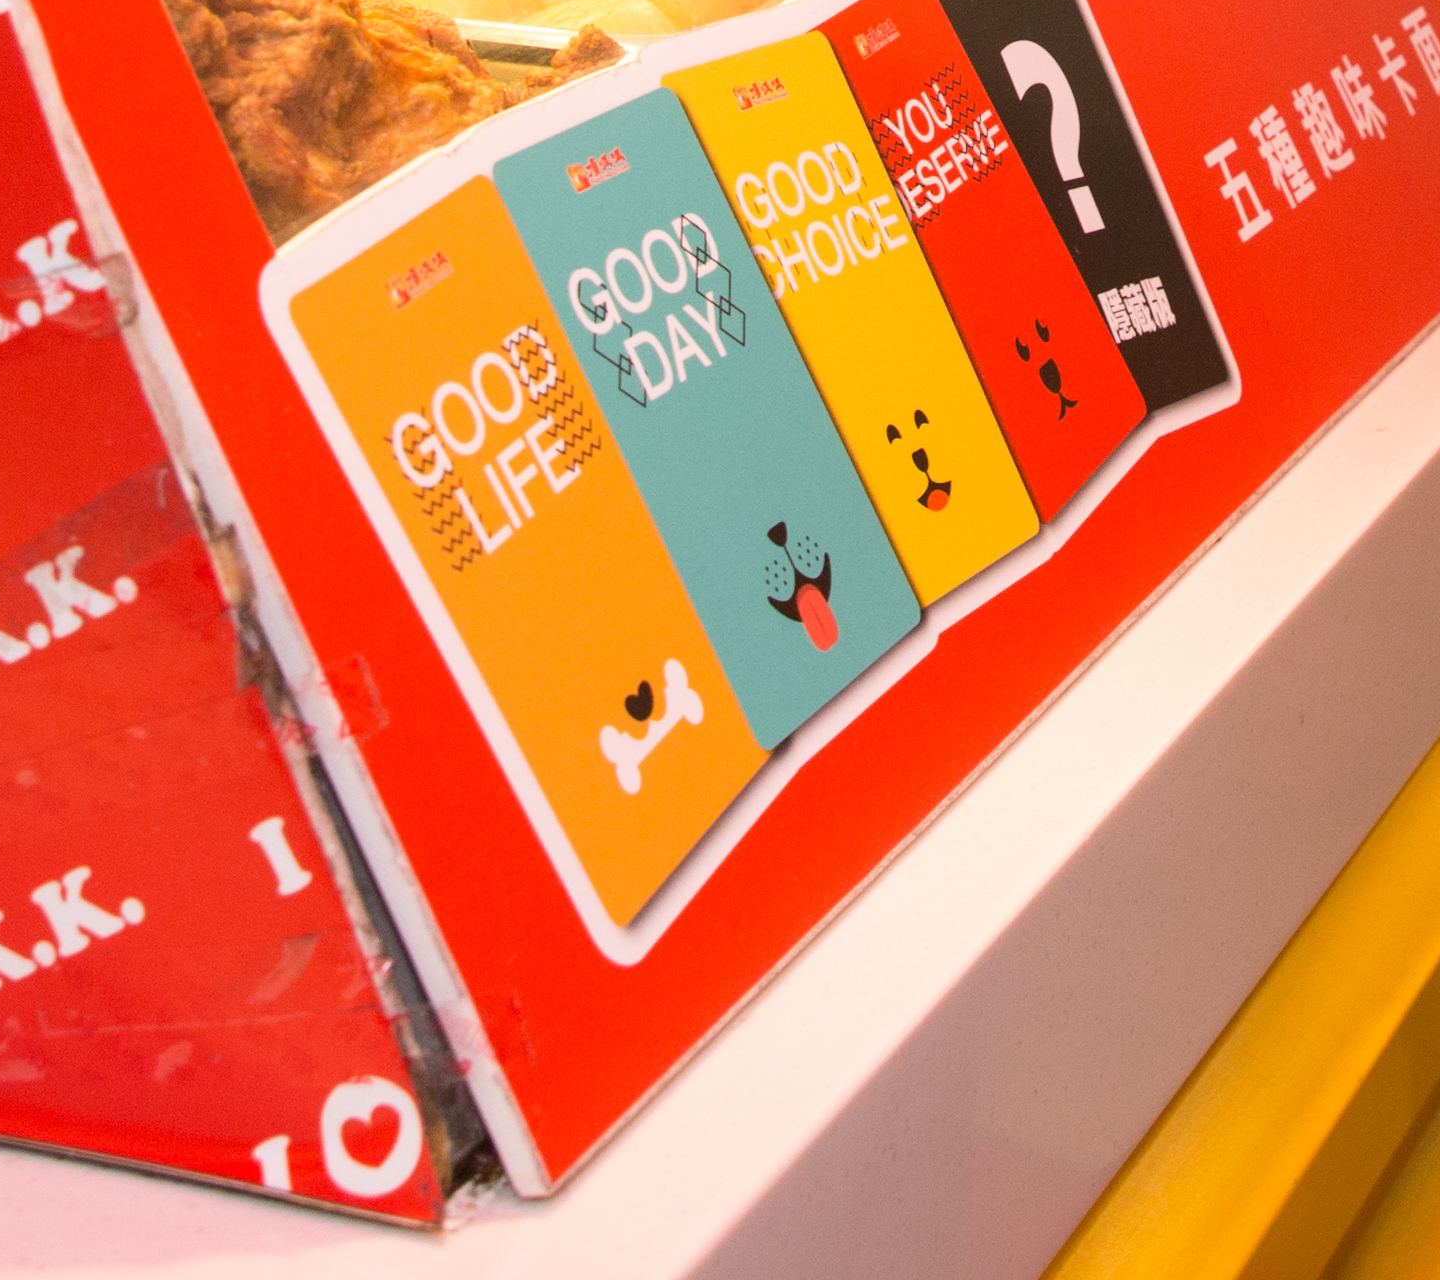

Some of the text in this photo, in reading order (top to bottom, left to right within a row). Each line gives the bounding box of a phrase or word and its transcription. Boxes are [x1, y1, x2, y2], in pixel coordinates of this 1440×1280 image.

[883, 83, 954, 156] YOU
[734, 140, 863, 230] GOOD
[567, 212, 721, 336] GOOD
[1097, 275, 1177, 345] 隱藏版
[622, 291, 729, 402] DAY
[391, 324, 558, 490] GOOD
[455, 413, 583, 556] LIFE
